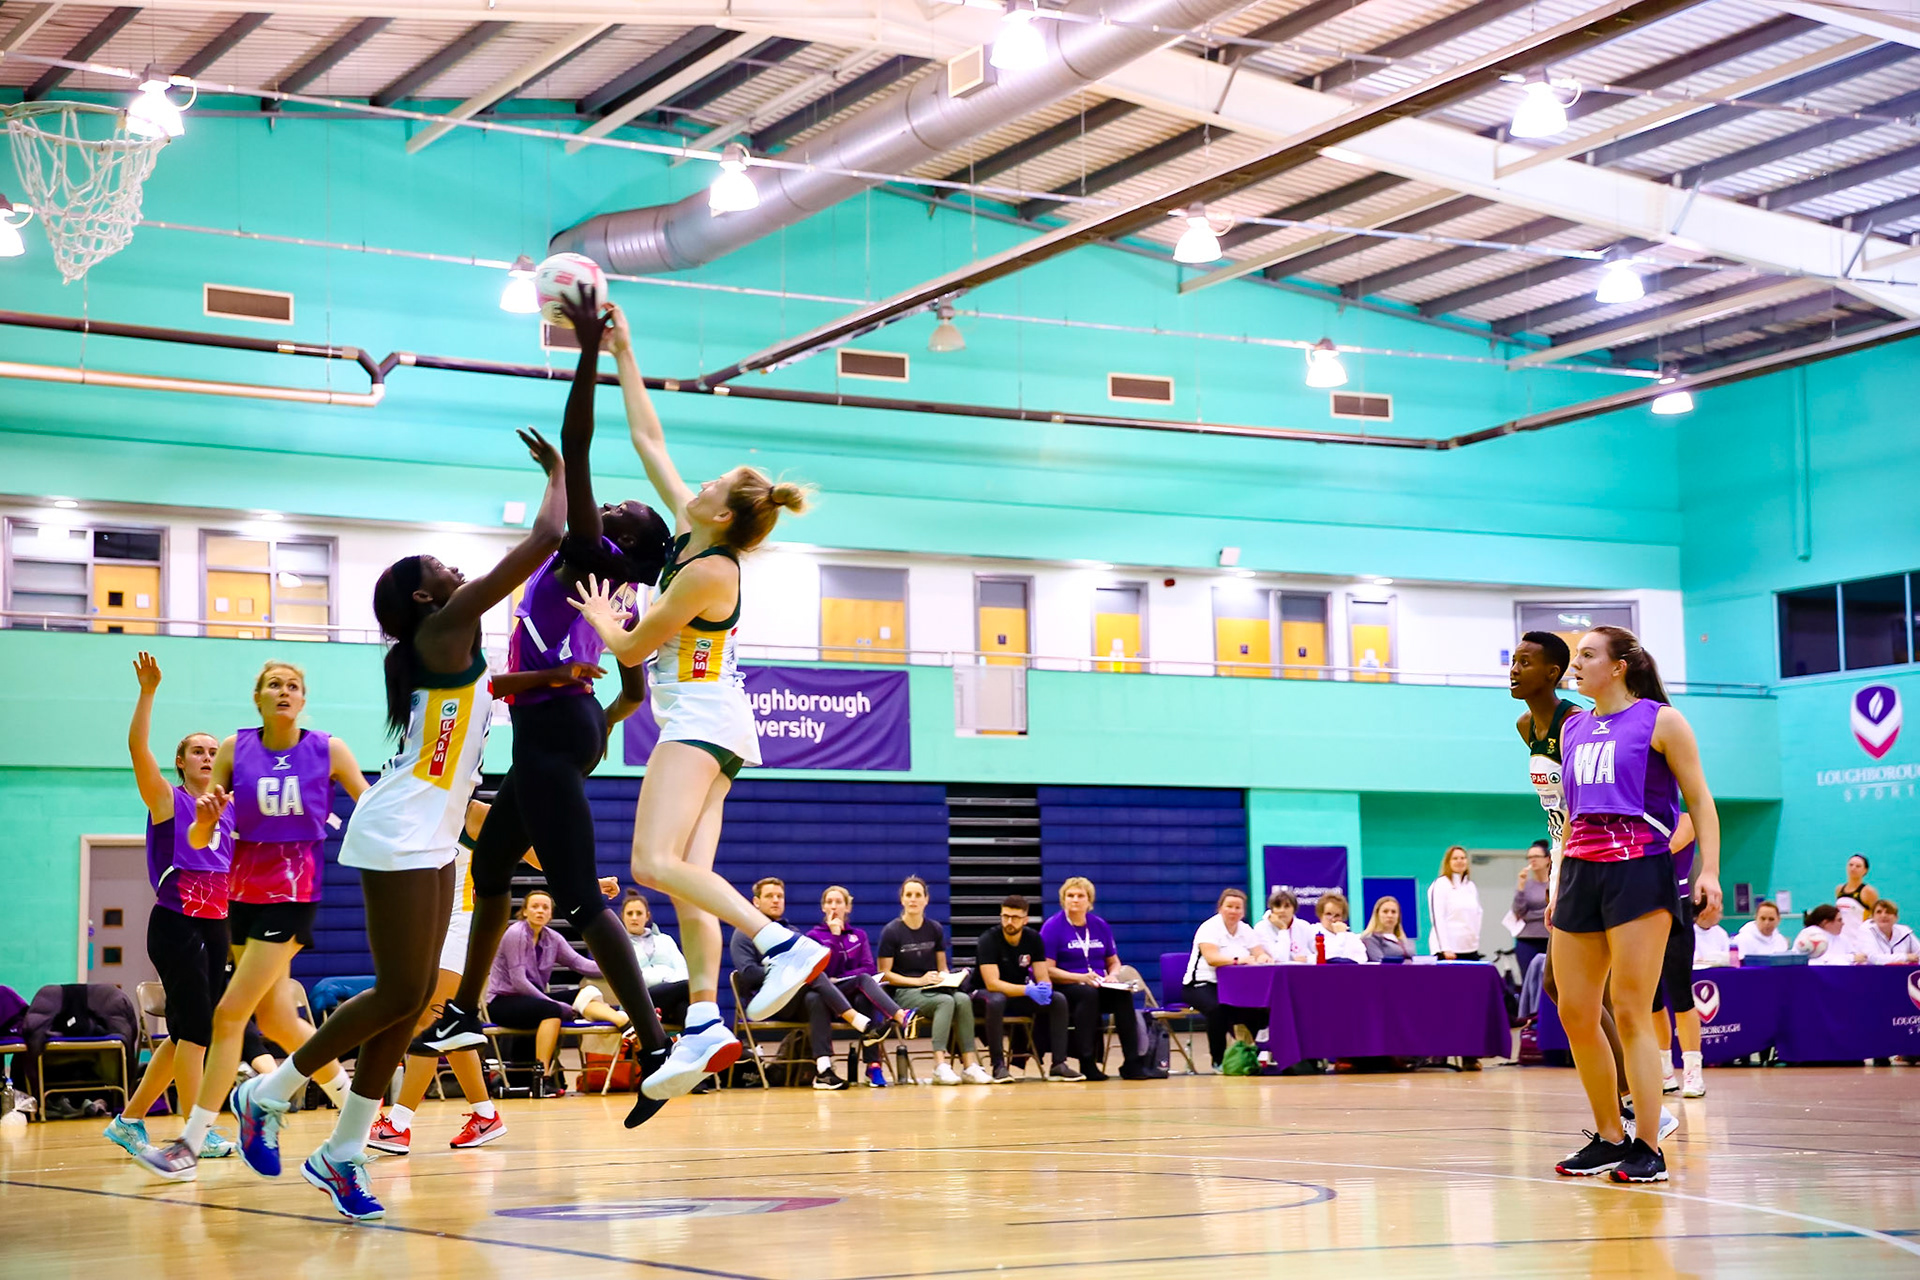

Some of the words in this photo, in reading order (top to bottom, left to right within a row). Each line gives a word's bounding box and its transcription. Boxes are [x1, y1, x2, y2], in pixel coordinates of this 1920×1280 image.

[746, 687, 871, 718] ughborough
[433, 719, 453, 763] SPAR
[755, 715, 826, 744] versity
[1573, 740, 1616, 787] WA
[257, 775, 304, 816] GA
